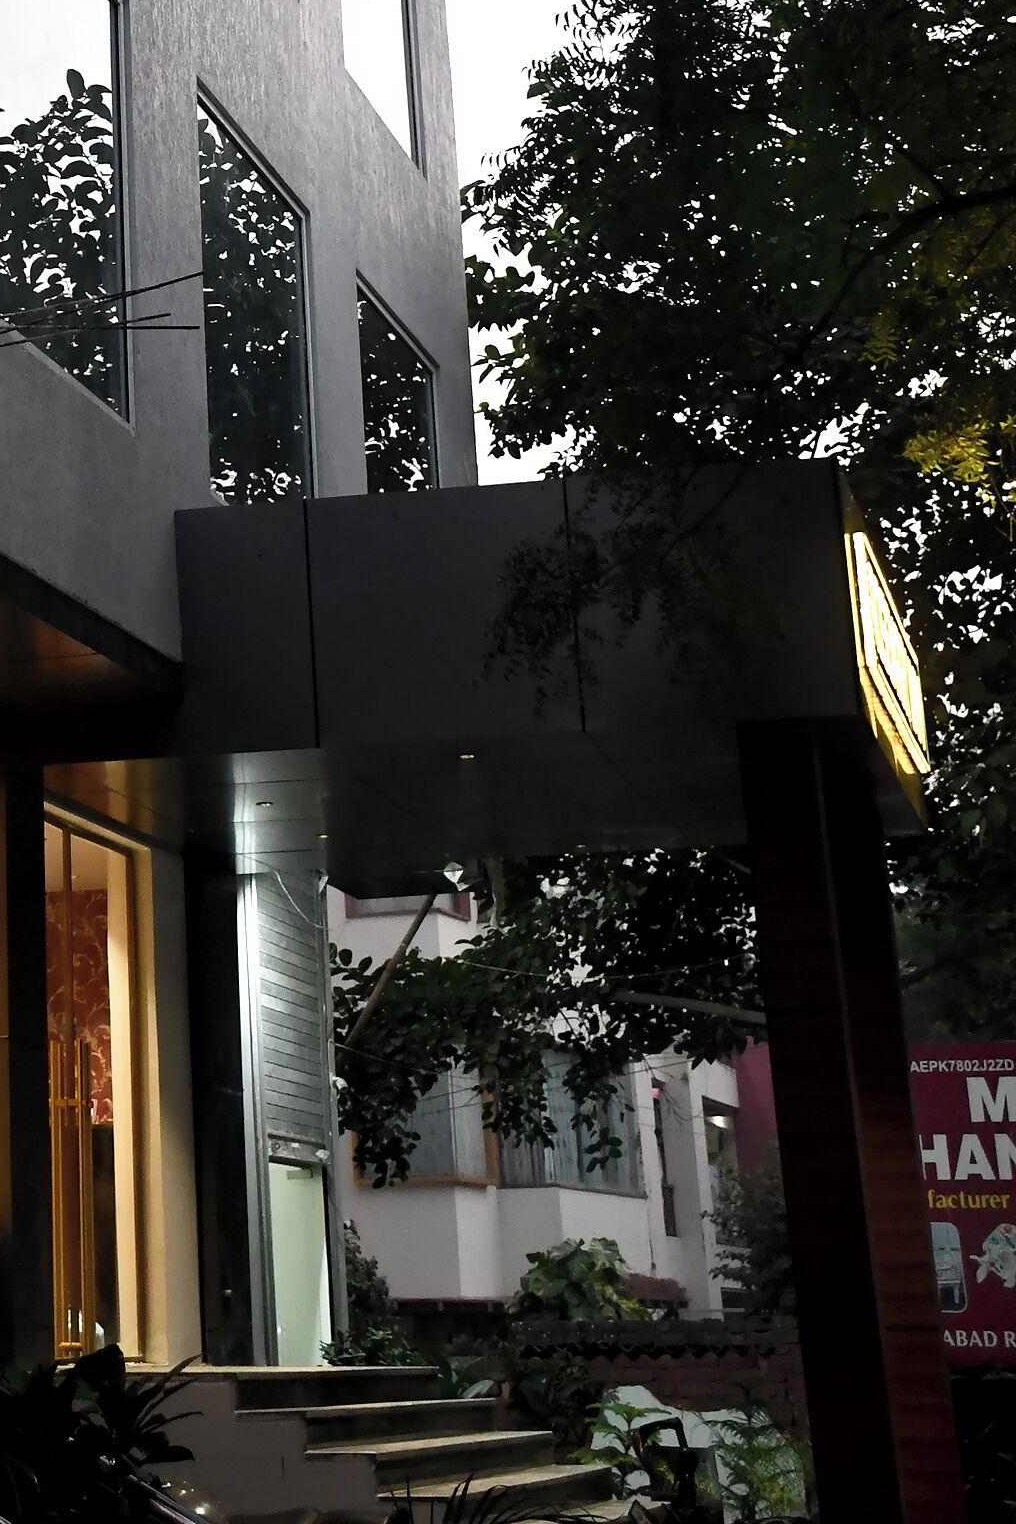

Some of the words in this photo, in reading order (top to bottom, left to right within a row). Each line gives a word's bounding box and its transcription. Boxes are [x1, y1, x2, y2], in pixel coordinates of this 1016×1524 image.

[965, 1076, 1016, 1123] M
[927, 1188, 1010, 1209] facturer
[943, 1329, 998, 1348] ABAD
